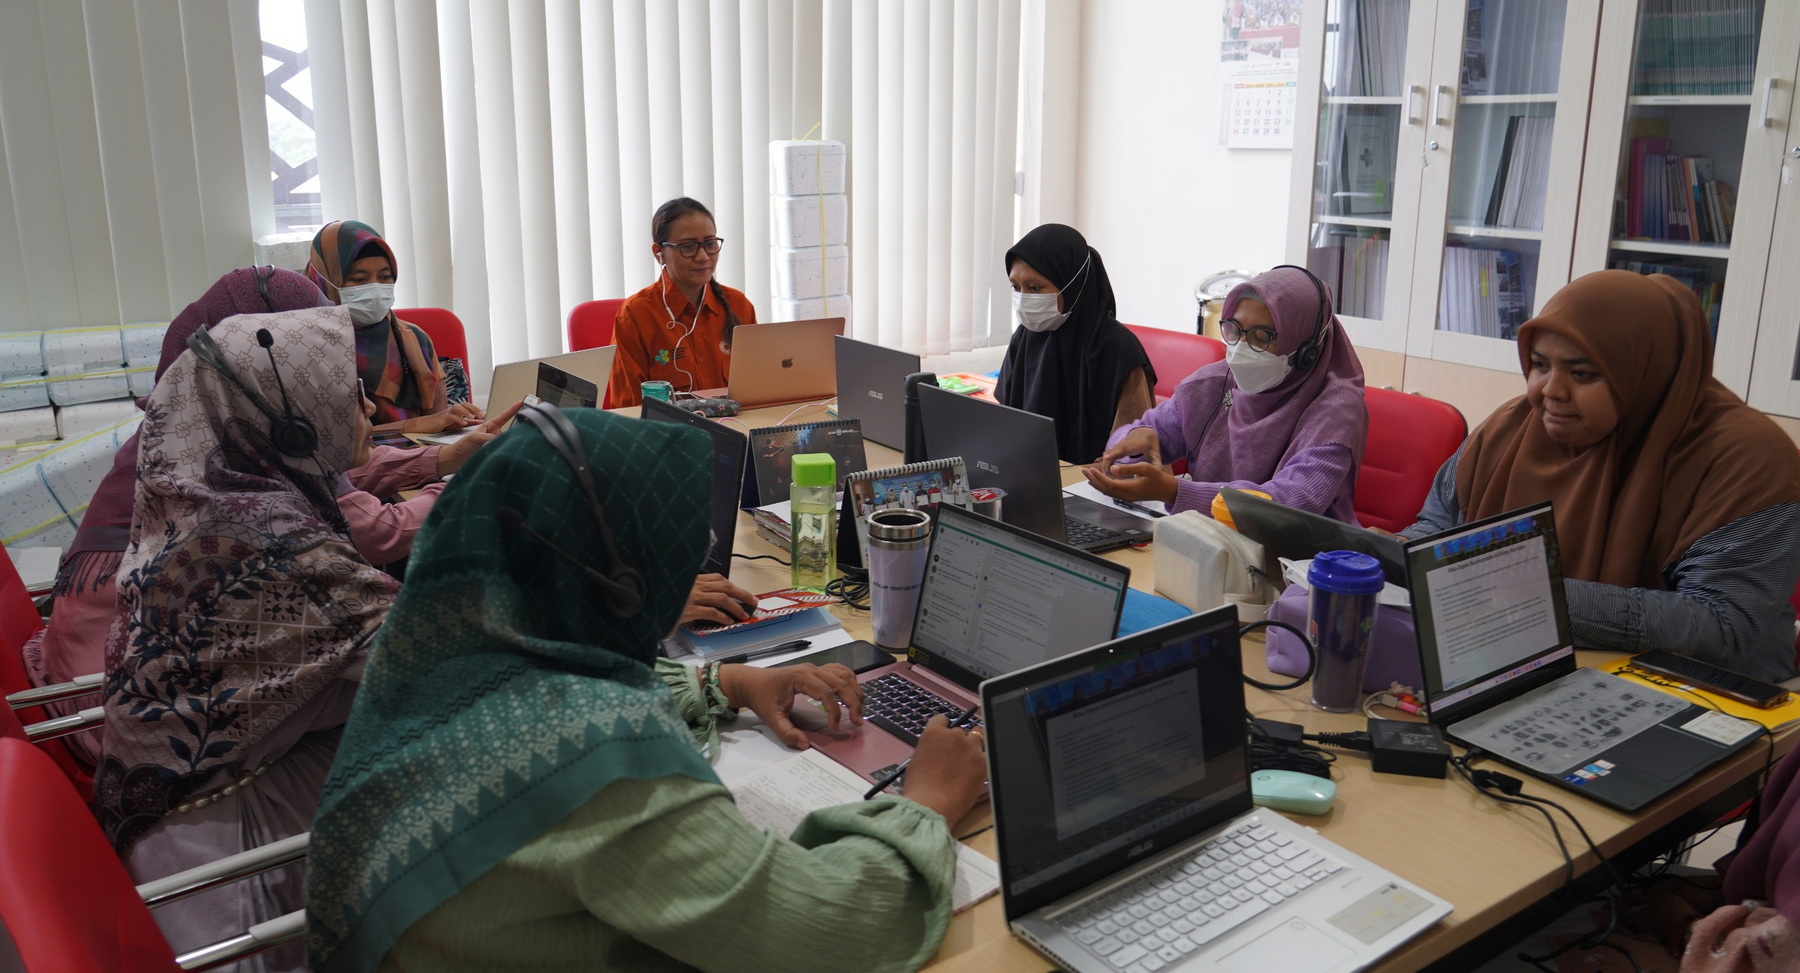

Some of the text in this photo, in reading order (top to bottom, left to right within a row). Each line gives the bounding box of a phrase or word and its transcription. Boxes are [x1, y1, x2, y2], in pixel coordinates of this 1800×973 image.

[868, 390, 884, 400] ASUS
[976, 460, 1000, 475] ASUS
[1128, 840, 1154, 858] ASUS
